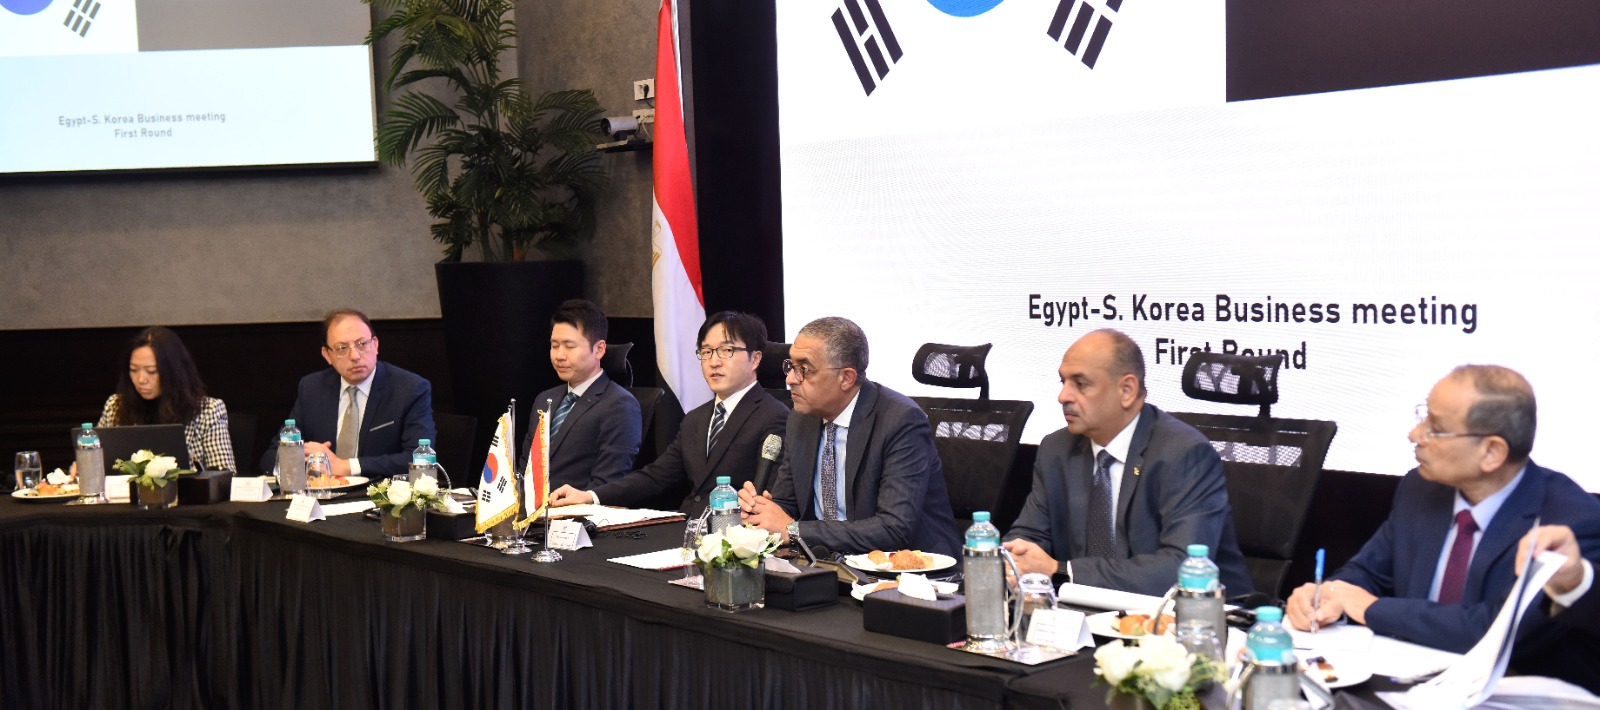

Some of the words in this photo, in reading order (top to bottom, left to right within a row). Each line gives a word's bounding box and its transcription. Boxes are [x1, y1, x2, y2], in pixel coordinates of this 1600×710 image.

[58, 114, 102, 128] Egypt-S.
[104, 114, 134, 125] Korea
[137, 113, 183, 124] Business
[186, 112, 226, 123] meeting
[114, 129, 138, 139] First
[140, 127, 172, 138] Round
[1028, 293, 1123, 328] Egypt-S.
[1132, 293, 1205, 322] Korea
[1215, 294, 1341, 324] Business
[1352, 295, 1477, 334] meeting
